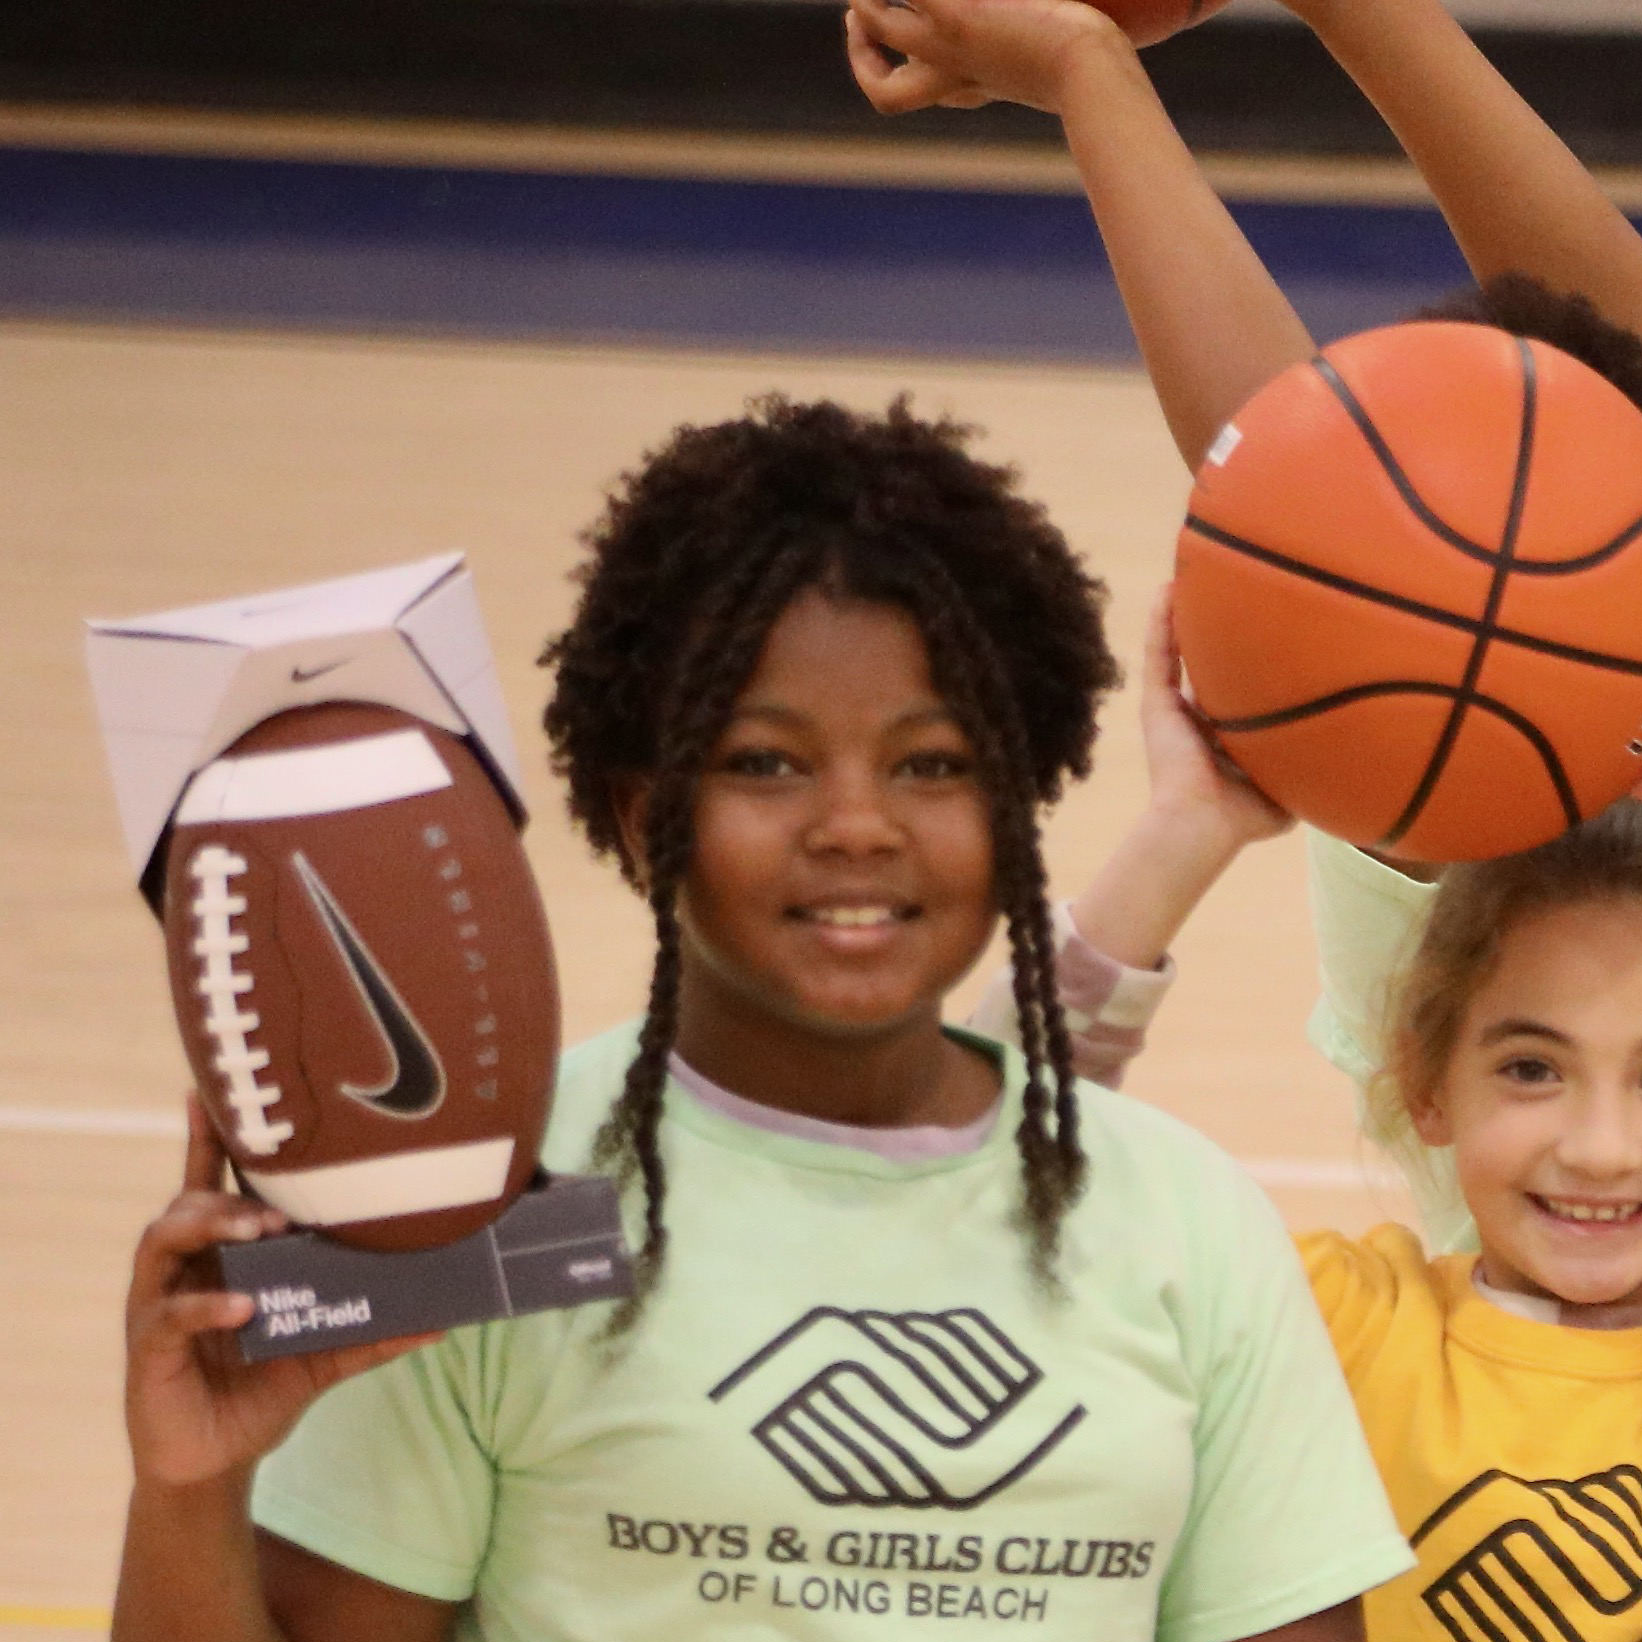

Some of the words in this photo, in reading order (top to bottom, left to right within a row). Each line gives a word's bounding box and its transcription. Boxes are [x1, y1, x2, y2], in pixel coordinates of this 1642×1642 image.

[259, 1285, 317, 1315] Nike
[269, 1297, 373, 1338] All-Field
[607, 1512, 749, 1560] BOYS
[766, 1525, 809, 1563] &
[825, 1530, 984, 1574] GIRLS
[995, 1536, 1155, 1580] CLUBS
[699, 1570, 758, 1602] OF
[771, 1575, 892, 1615] LONG
[905, 1580, 1050, 1622] BEACH
